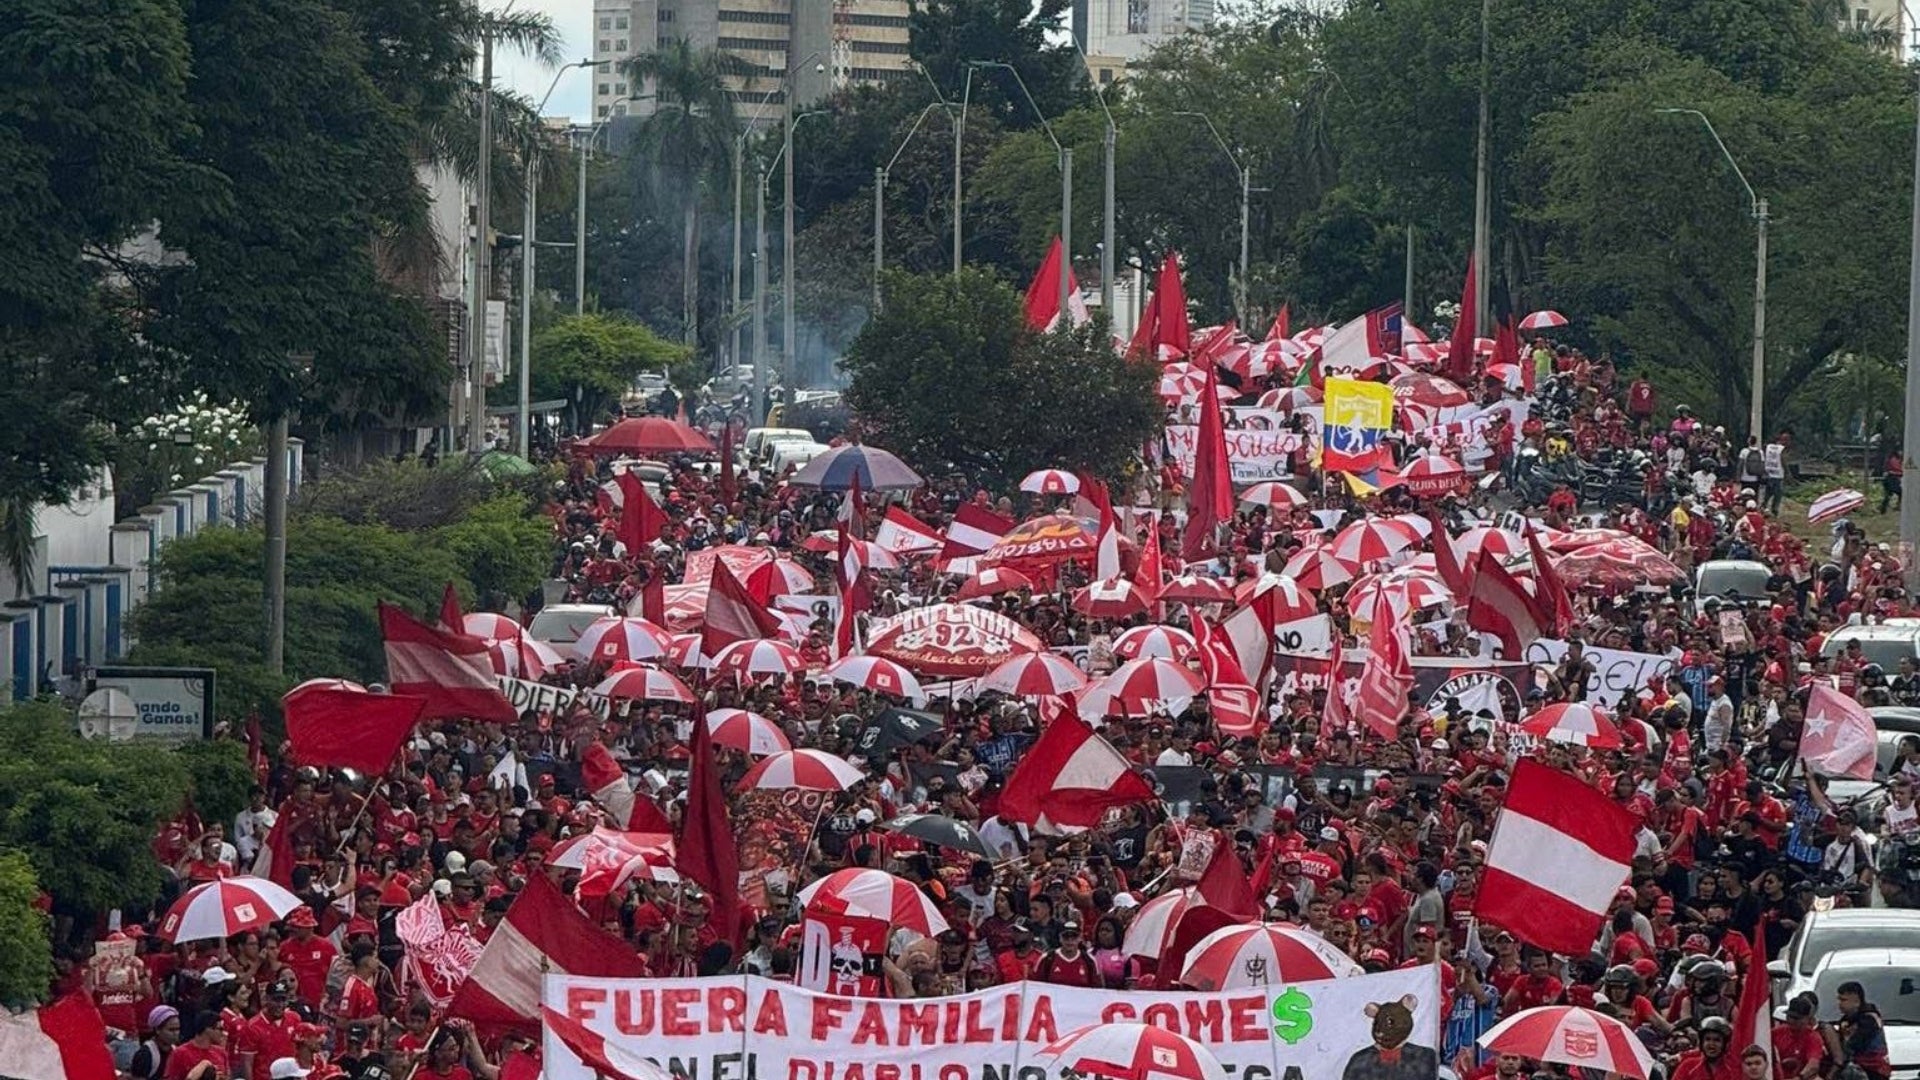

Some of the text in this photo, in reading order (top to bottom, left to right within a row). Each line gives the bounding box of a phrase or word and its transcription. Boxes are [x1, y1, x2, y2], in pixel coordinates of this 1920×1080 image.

[1504, 517, 1521, 534] LA
[935, 624, 974, 647] 92
[1275, 630, 1302, 651] NO
[142, 713, 199, 724] Ganas!
[566, 987, 788, 1037] FUERA
[811, 994, 1058, 1045] FAMILIA
